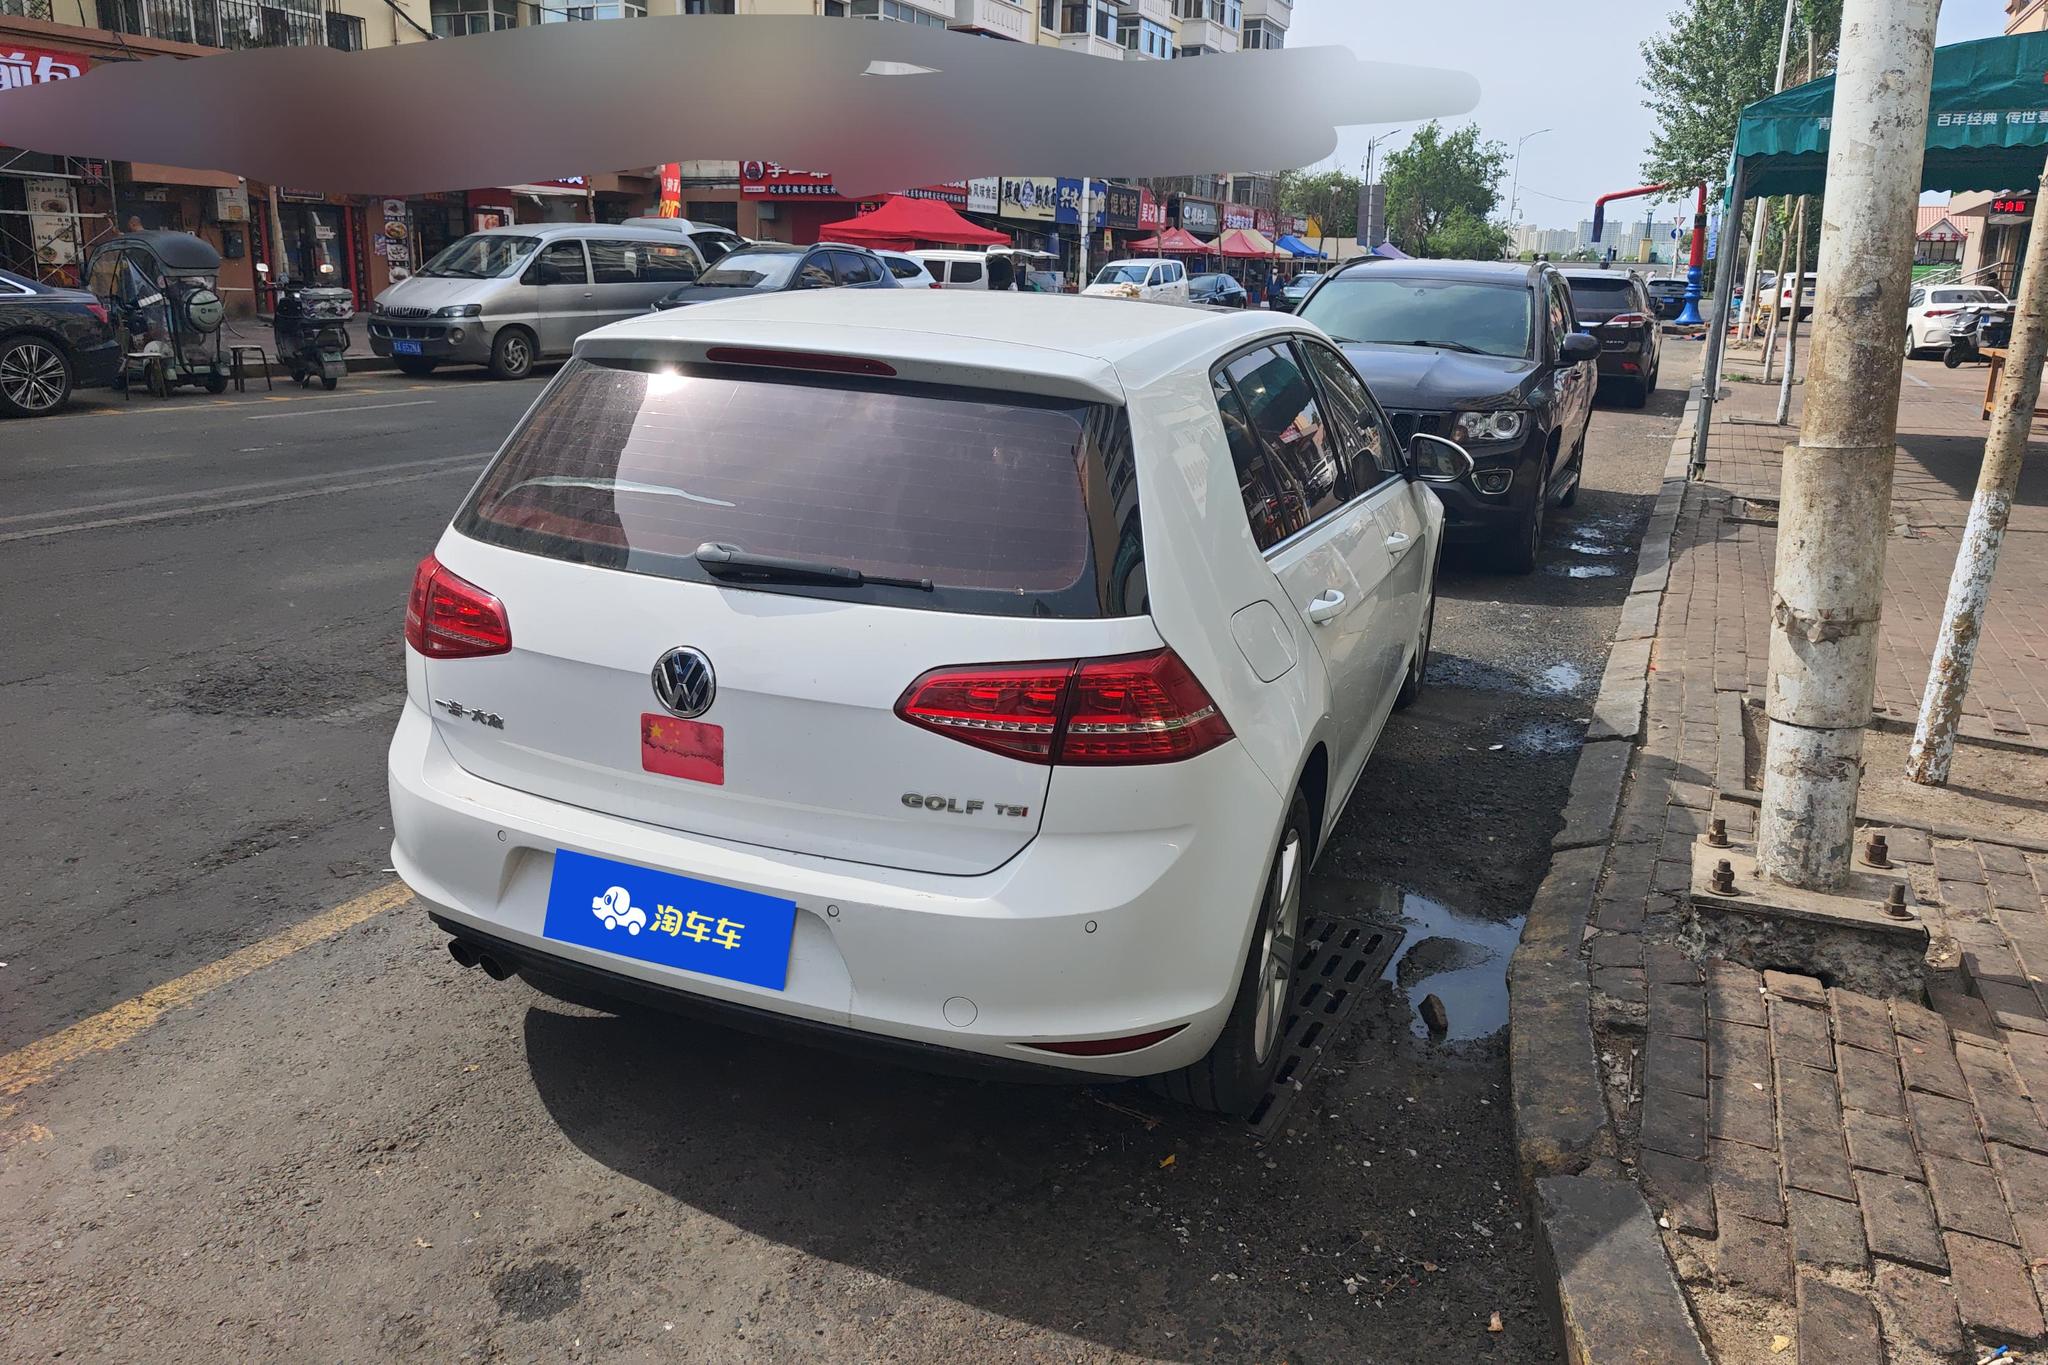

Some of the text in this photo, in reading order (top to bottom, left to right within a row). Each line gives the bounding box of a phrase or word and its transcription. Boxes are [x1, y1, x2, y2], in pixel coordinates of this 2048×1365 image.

[1937, 111, 1998, 127] 百年经典
[1994, 199, 2026, 212] 牛肉面
[901, 792, 1029, 817] GOLF TSI
